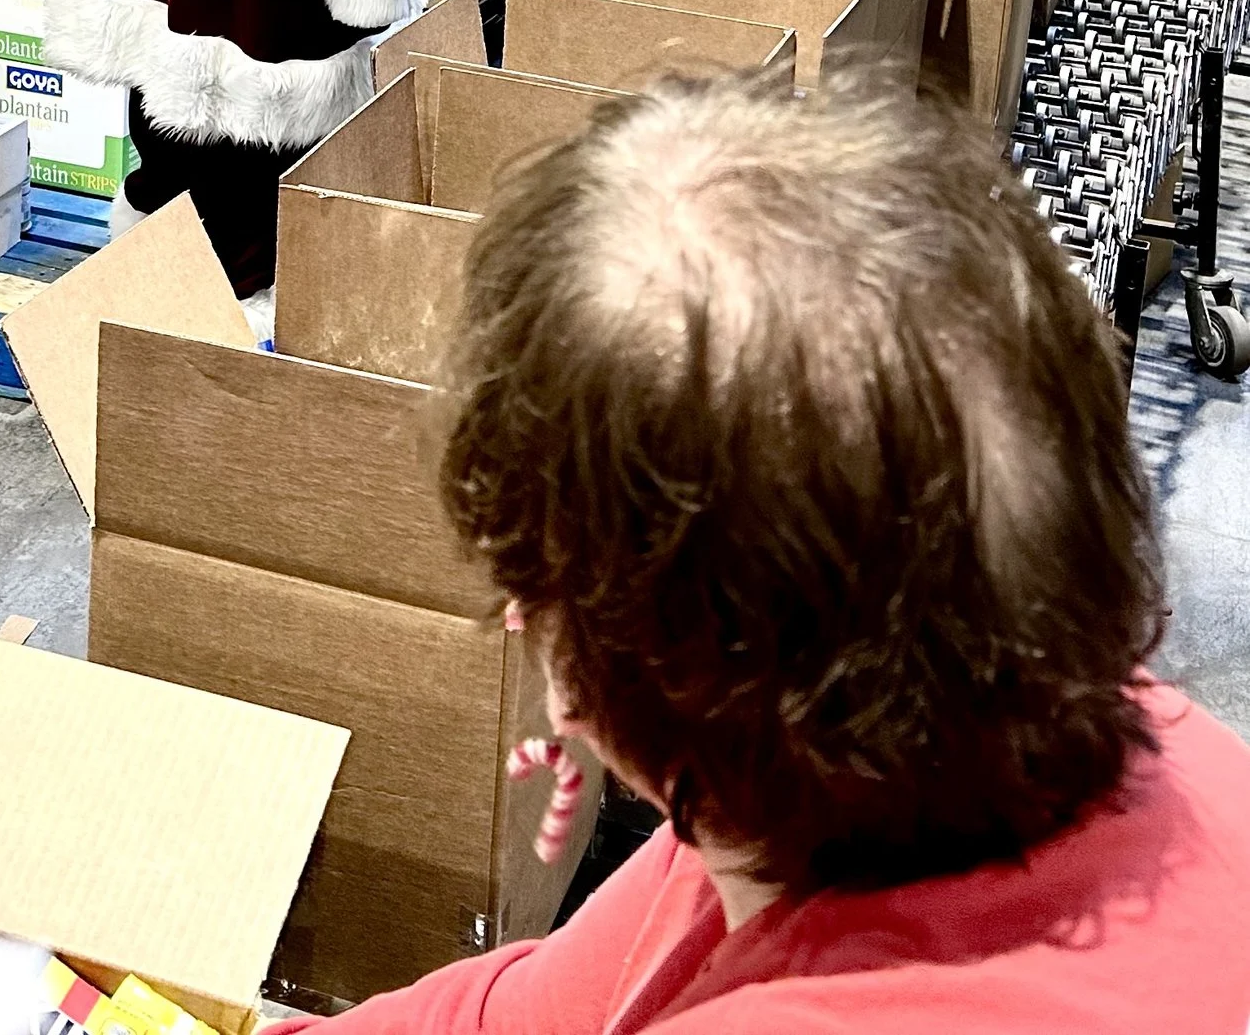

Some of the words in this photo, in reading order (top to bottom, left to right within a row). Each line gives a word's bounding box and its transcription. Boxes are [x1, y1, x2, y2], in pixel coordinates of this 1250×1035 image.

[9, 71, 62, 95] GOYA
[0, 96, 69, 123] plantain
[30, 164, 68, 185] ntain
[70, 172, 118, 193] STRIPS
